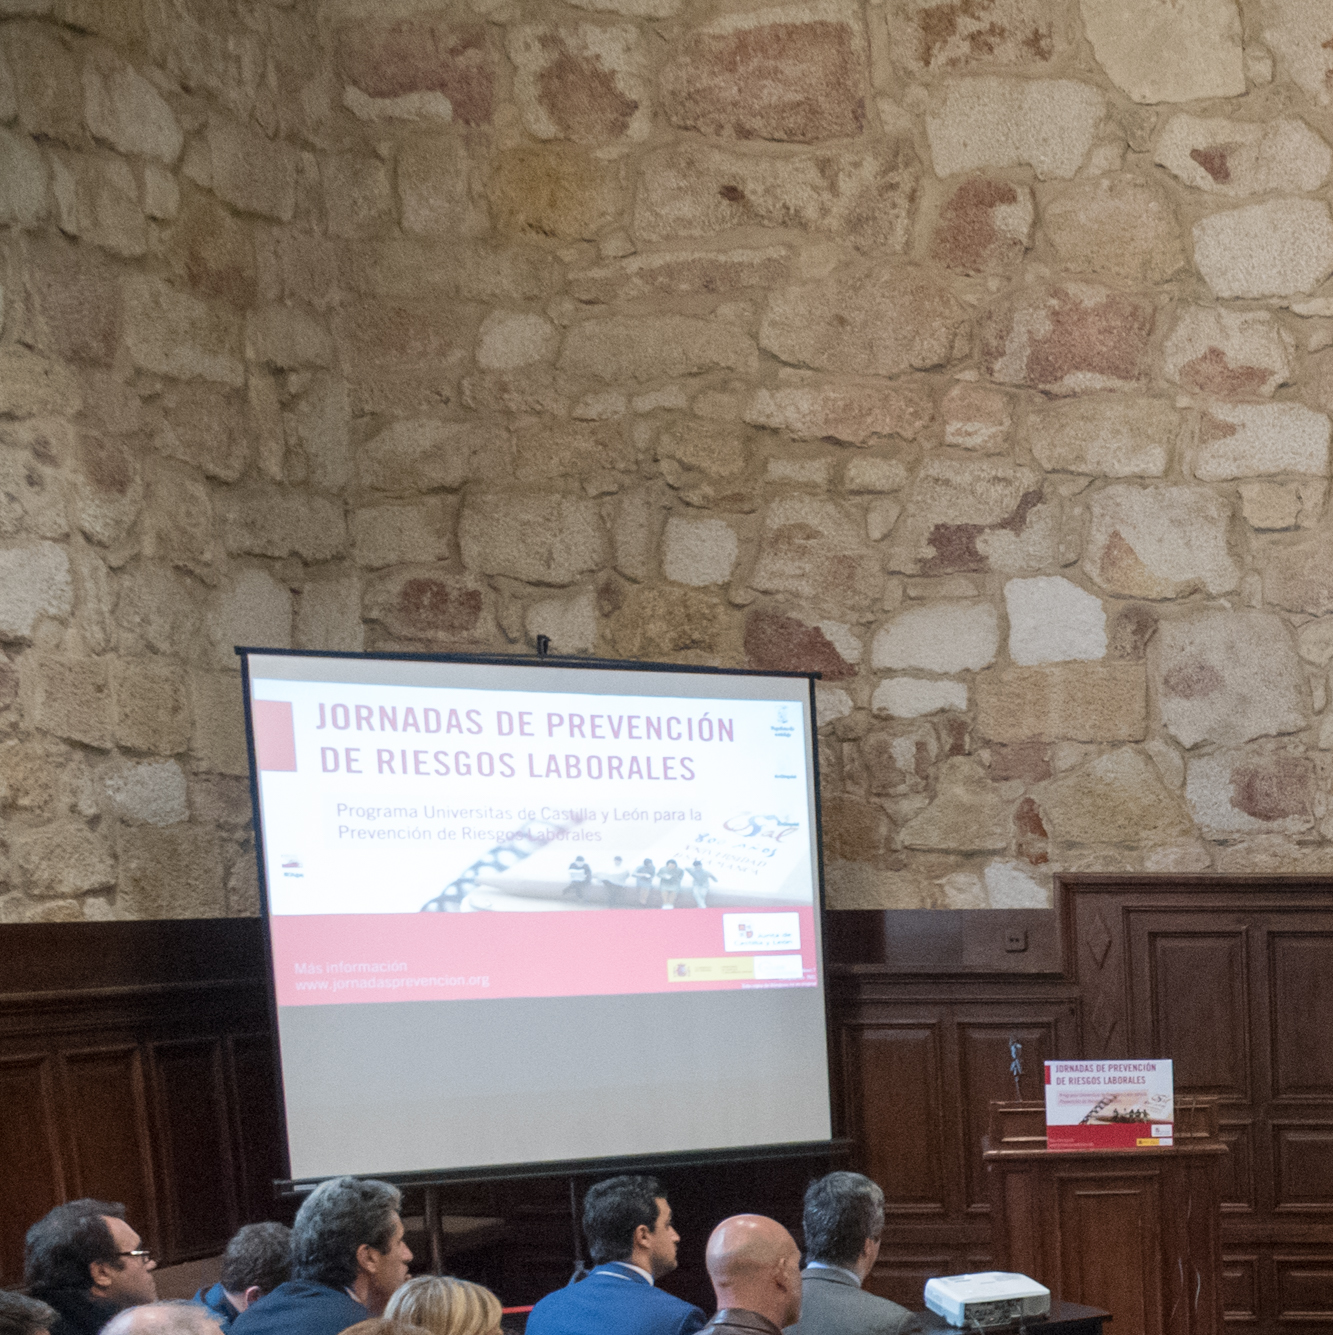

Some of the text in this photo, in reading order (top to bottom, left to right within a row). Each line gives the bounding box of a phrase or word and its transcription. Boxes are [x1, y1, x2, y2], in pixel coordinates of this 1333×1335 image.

[316, 702, 483, 735] JORNADAS
[496, 710, 535, 737] DE
[547, 711, 734, 743] PREVENCIÓN
[320, 746, 696, 781] DE RIESGOS LABORALES
[336, 803, 702, 824] Programa Universitas de Castilla y León para la
[338, 825, 602, 844] Prevención de Riesgos Laborales
[294, 960, 408, 975] Más información
[295, 975, 490, 993] www.jornadasprevencion.org
[1056, 1062, 1157, 1073] JORNADAS DE PREVENCIÓN
[1056, 1076, 1146, 1086] DE RIESGOS LABORALES
